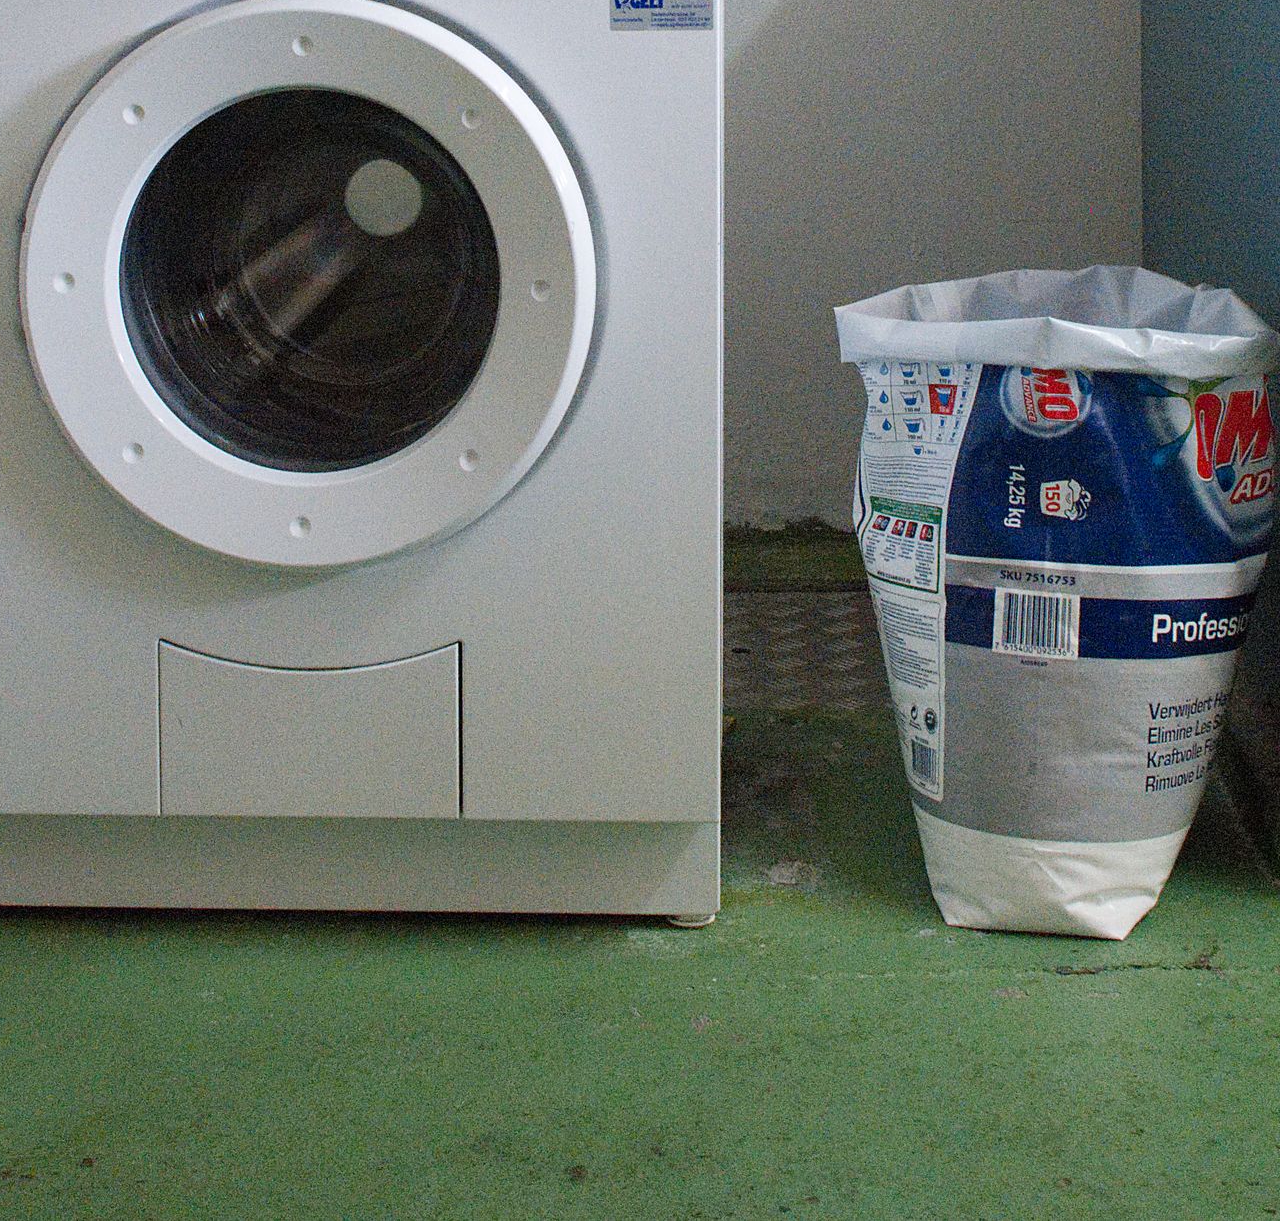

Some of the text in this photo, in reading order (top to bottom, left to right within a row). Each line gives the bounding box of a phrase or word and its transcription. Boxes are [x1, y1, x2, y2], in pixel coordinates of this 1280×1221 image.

[1021, 377, 1037, 424] ADVANCE
[1004, 464, 1025, 528] 14,25 kg
[1045, 483, 1060, 513] 150
[1000, 569, 1076, 586] SKU 7516753
[1149, 697, 1213, 720] Verwijdert
[1148, 722, 1193, 745] Elimine
[1195, 720, 1211, 736] Les
[1147, 742, 1202, 769] Kraftvolle
[1145, 769, 1195, 792] Rimuove
